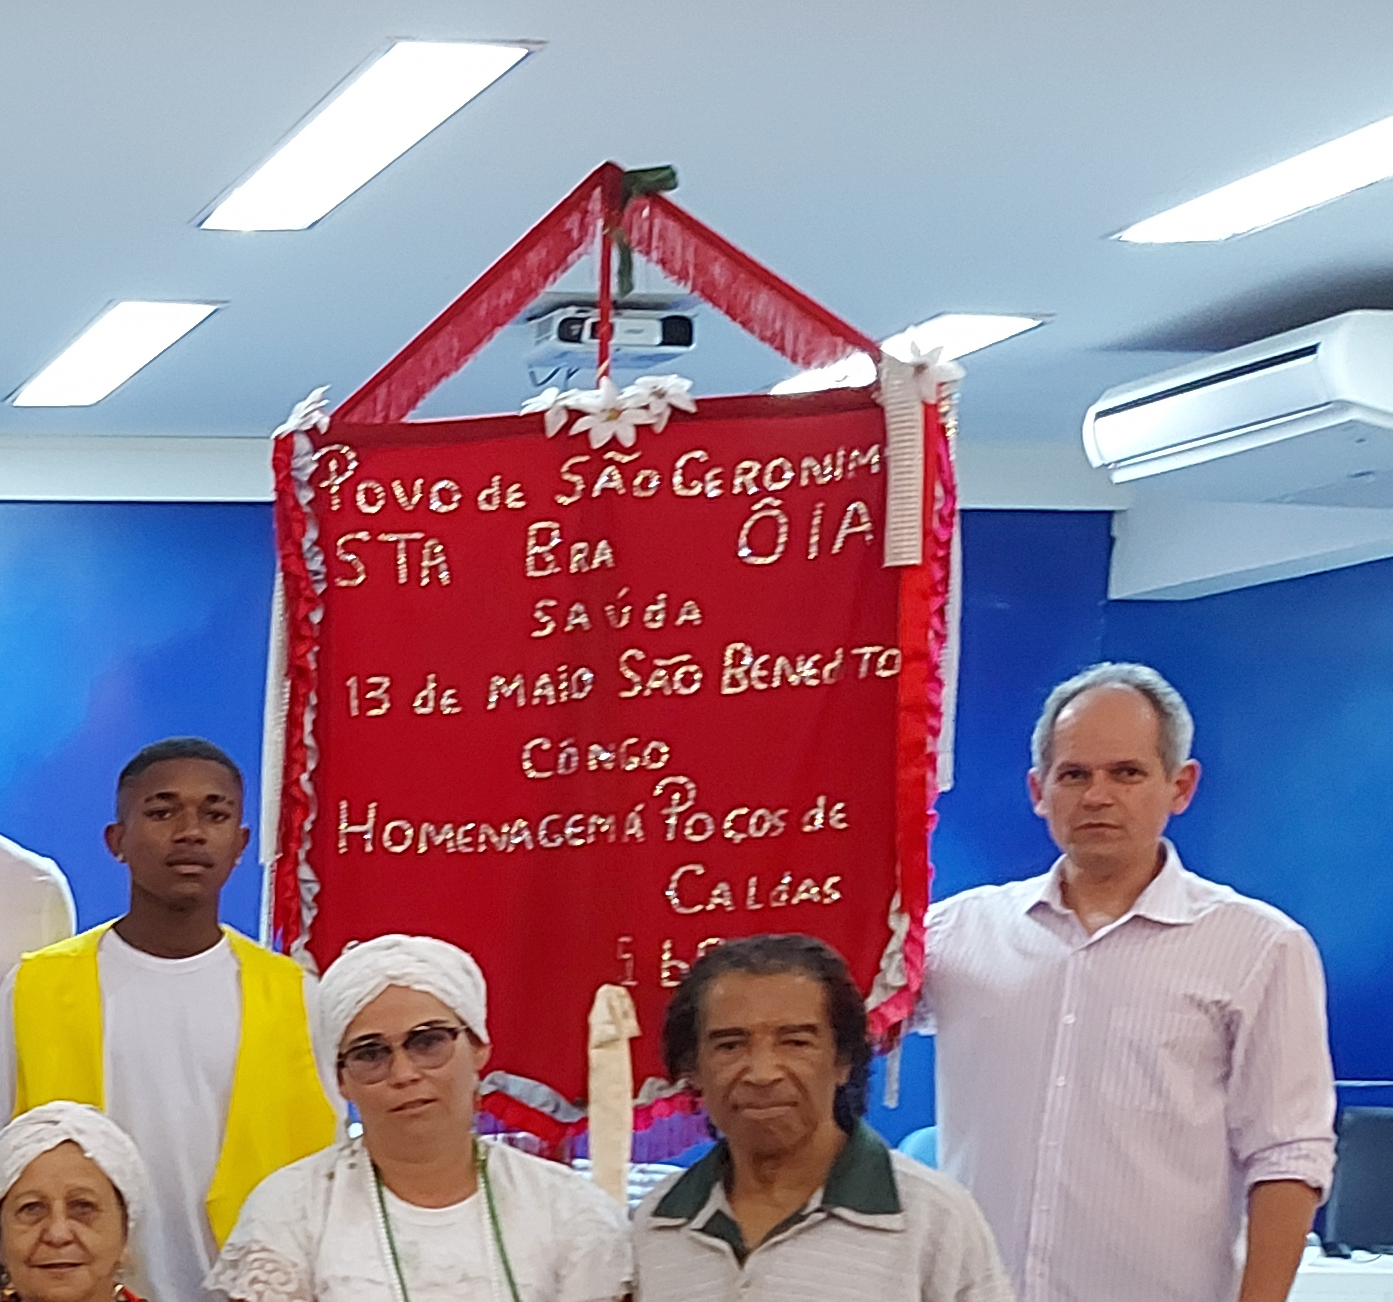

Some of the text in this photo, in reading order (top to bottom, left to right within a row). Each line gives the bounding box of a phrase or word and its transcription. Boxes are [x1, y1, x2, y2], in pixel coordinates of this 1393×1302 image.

[312, 444, 462, 514] POVO
[555, 450, 662, 505] SÃO
[671, 444, 885, 498] GERONIM
[334, 496, 875, 587] STA BRA ÔIA
[346, 674, 391, 716] 13
[618, 648, 704, 699] SÃO
